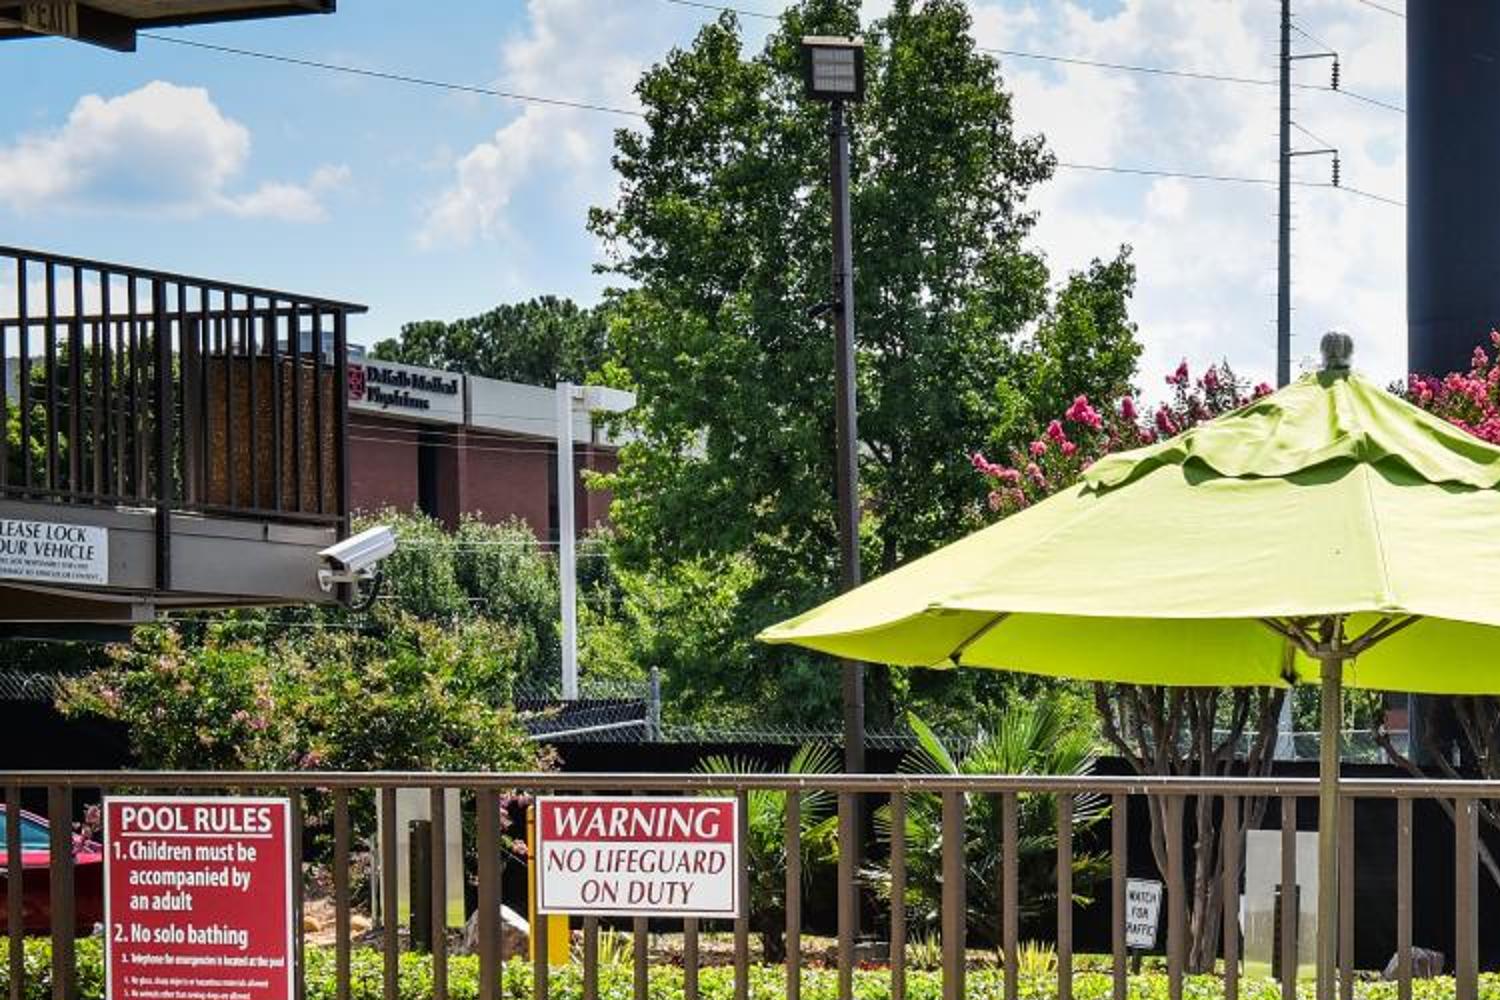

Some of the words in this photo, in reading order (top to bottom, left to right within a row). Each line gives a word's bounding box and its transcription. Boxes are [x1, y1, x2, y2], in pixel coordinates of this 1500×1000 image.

[0, 520, 42, 538] LEASE
[46, 525, 87, 542] LOCK
[0, 539, 27, 555] OUR
[33, 541, 95, 561] VEHICLE
[121, 807, 189, 831] POOL
[194, 807, 272, 833] RULES
[553, 806, 721, 839] WARNING
[113, 841, 127, 860] 1.
[129, 841, 192, 861] Children
[195, 843, 234, 861] must
[237, 842, 257, 861] be
[547, 848, 586, 873] NO
[594, 849, 726, 875] LIFEGUARD
[129, 867, 229, 891] accompanied
[231, 867, 251, 892] by
[129, 896, 149, 910] an
[152, 891, 193, 911] adult
[581, 879, 619, 903] ON
[628, 881, 695, 906] DUTY
[114, 924, 128, 942] 2.
[131, 924, 151, 943] No
[154, 924, 186, 944] solo
[187, 924, 249, 950] bathing
